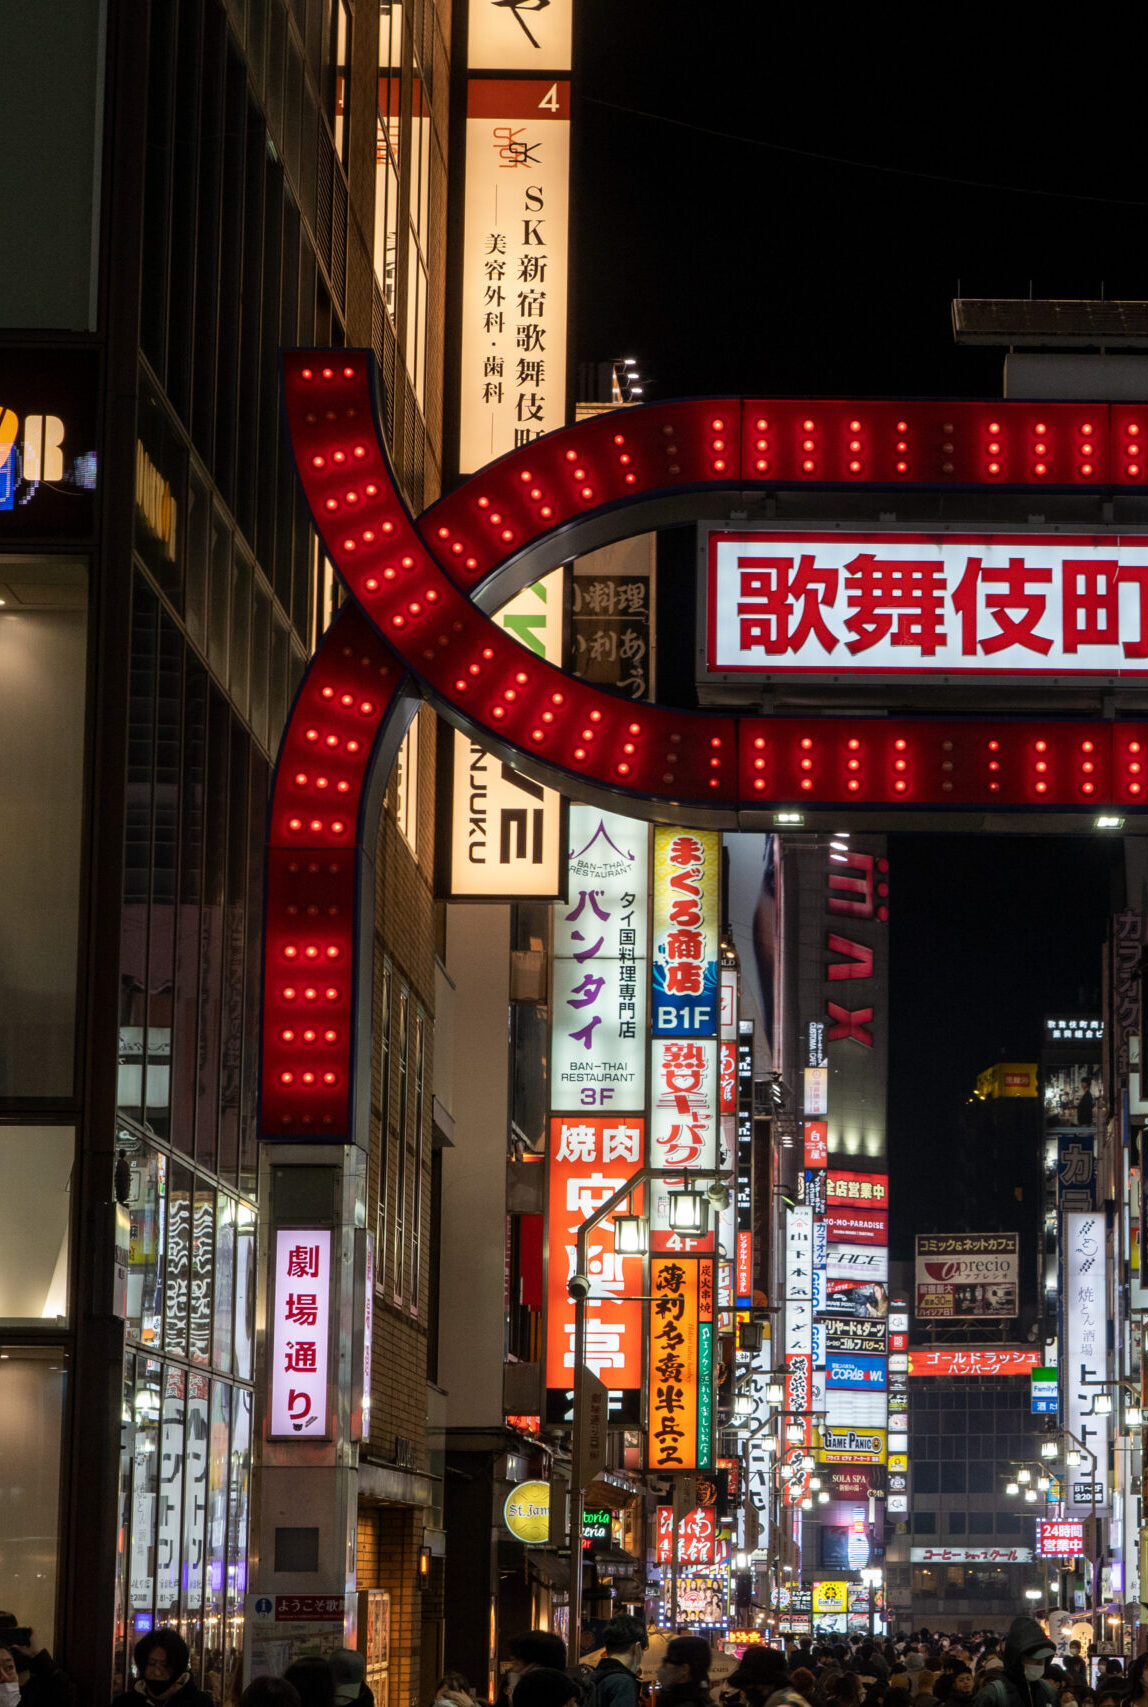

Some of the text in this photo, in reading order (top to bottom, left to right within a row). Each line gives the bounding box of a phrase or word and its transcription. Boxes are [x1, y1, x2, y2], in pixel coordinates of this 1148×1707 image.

[538, 83, 560, 112] 4
[482, 233, 507, 404] 美容外科・歯科
[569, 864, 633, 878] RESTAURANT
[577, 859, 625, 872] BAN-THAI
[665, 836, 705, 997] まぐろ商店
[565, 889, 612, 1050] バンタイ
[618, 891, 637, 1039] タイ国料理専門店
[658, 1006, 711, 1029] B1F
[1052, 1029, 1104, 1039] 振興組合ビ
[569, 1061, 628, 1071] BAN-THAI
[560, 1072, 636, 1082] RESTAURANT
[580, 1087, 615, 1106] 3F
[555, 1124, 641, 1164] 焼肉
[826, 1178, 886, 1201] 全店営業中
[665, 1233, 698, 1251] 4F
[815, 1223, 826, 1264] カラオケ
[919, 1238, 1016, 1252] コミック&ネットカフェ
[826, 1251, 885, 1267] FACE
[699, 1265, 712, 1314] 炭火串焼
[284, 1244, 320, 1420] 劇場通り
[948, 1363, 1001, 1375] ハンバーグ
[824, 1431, 872, 1449] GAME PANIC
[832, 1474, 866, 1483] SOLA SPA
[1043, 1524, 1083, 1538] 24時間
[1043, 1538, 1083, 1552] 営業中
